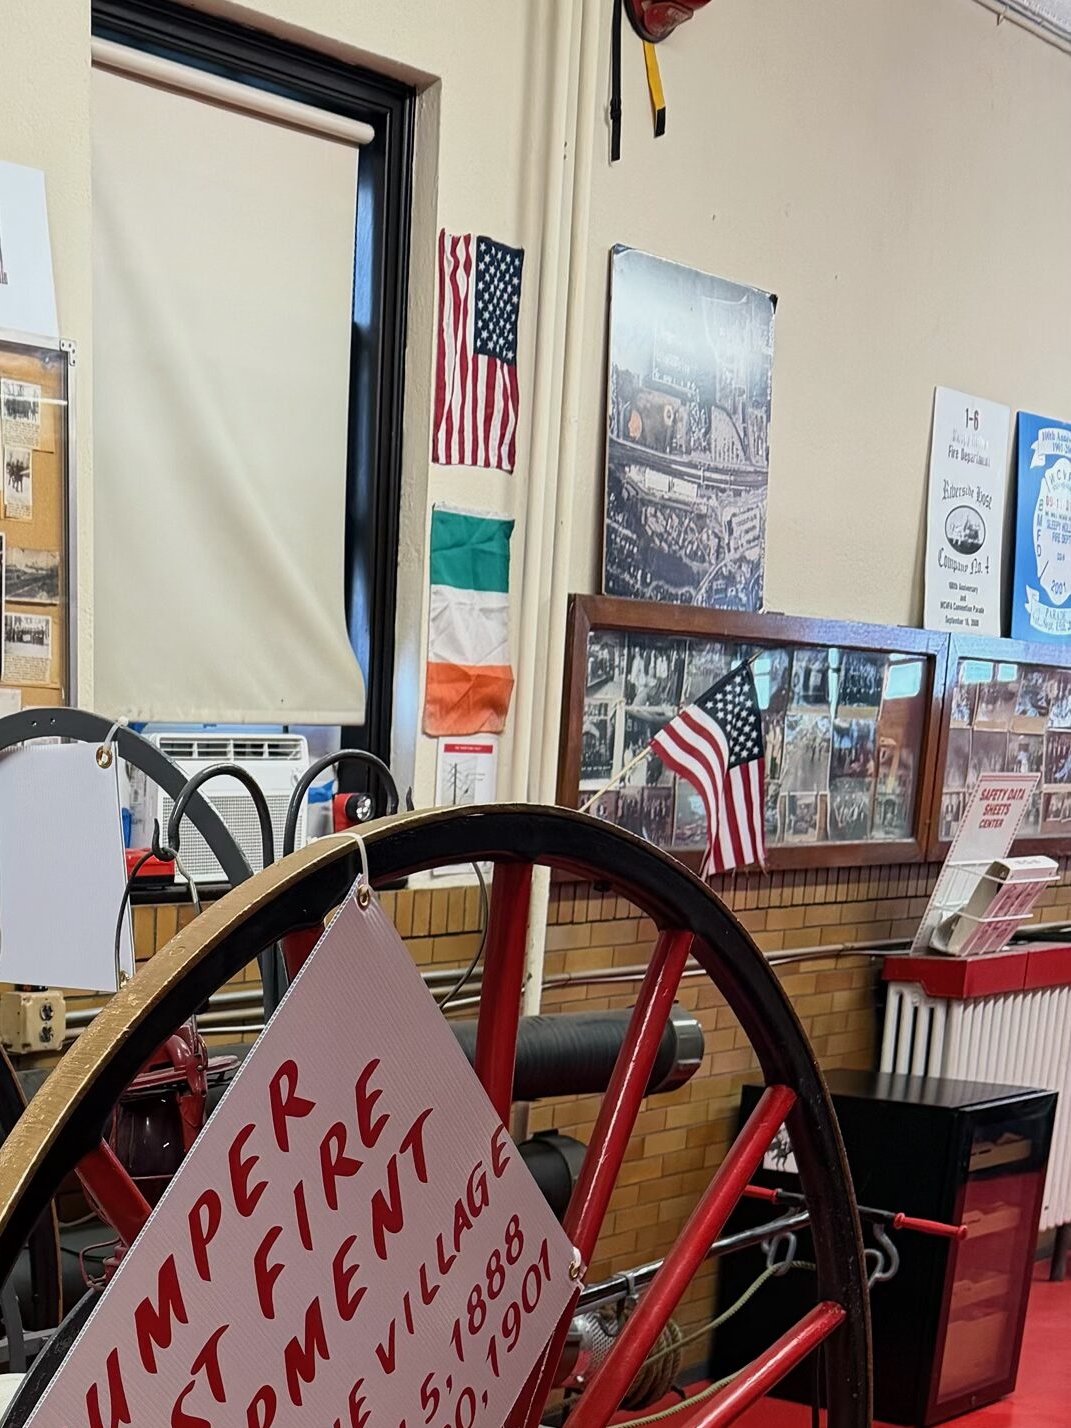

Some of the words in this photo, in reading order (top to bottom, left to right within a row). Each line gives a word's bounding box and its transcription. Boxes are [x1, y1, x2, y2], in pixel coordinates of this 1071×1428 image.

[965, 407, 980, 431] 1-6
[948, 444, 960, 460] Fire
[938, 547, 969, 573] Company
[979, 787, 1009, 801] SAFETY
[1007, 787, 1026, 801] DATA
[982, 802, 1012, 816] SHEETS
[978, 817, 1004, 829] CENTER
[253, 1059, 389, 1318] FIRE
[375, 1123, 511, 1374] VILLAGE
[420, 1371, 453, 1425] 5,
[449, 1214, 525, 1362] 1888
[486, 1237, 552, 1378] 1901
